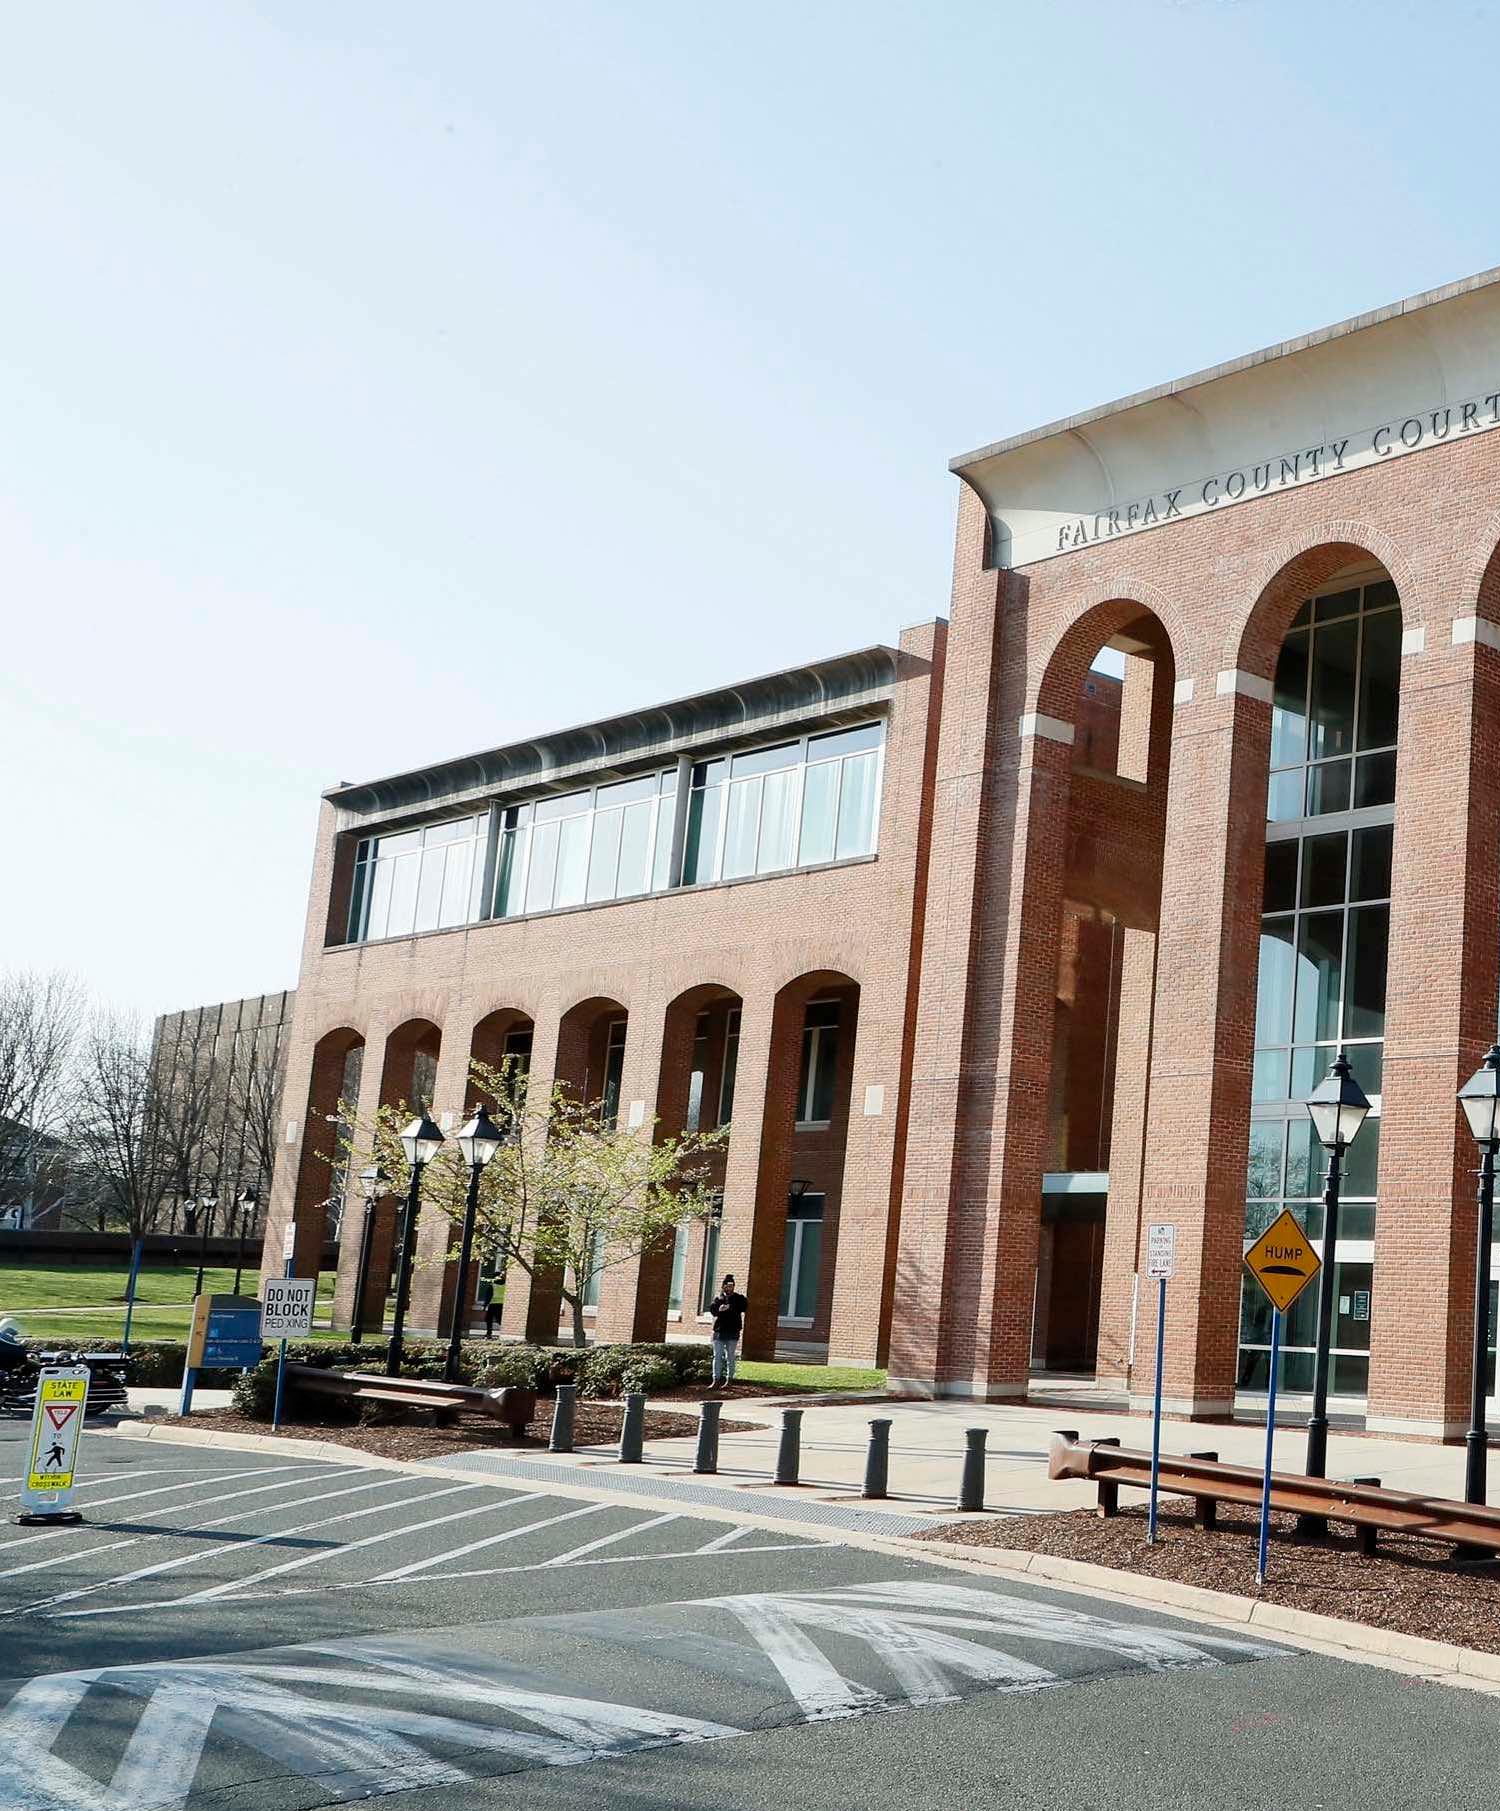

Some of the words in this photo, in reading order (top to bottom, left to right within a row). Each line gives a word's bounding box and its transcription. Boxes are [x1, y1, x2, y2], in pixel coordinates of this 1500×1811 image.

[1055, 489, 1183, 551] FAIRFAX
[1201, 439, 1349, 507] COUNTY
[1265, 1245, 1303, 1260] HUMP
[267, 1288, 284, 1302] DO
[287, 1288, 311, 1302] NOT
[266, 1303, 309, 1317] BLOCK
[265, 1318, 284, 1329] PED
[286, 1318, 308, 1329] XING
[50, 1381, 79, 1390] STATE
[52, 1390, 74, 1398] LAW
[31, 1480, 67, 1488] CROSSWALK
